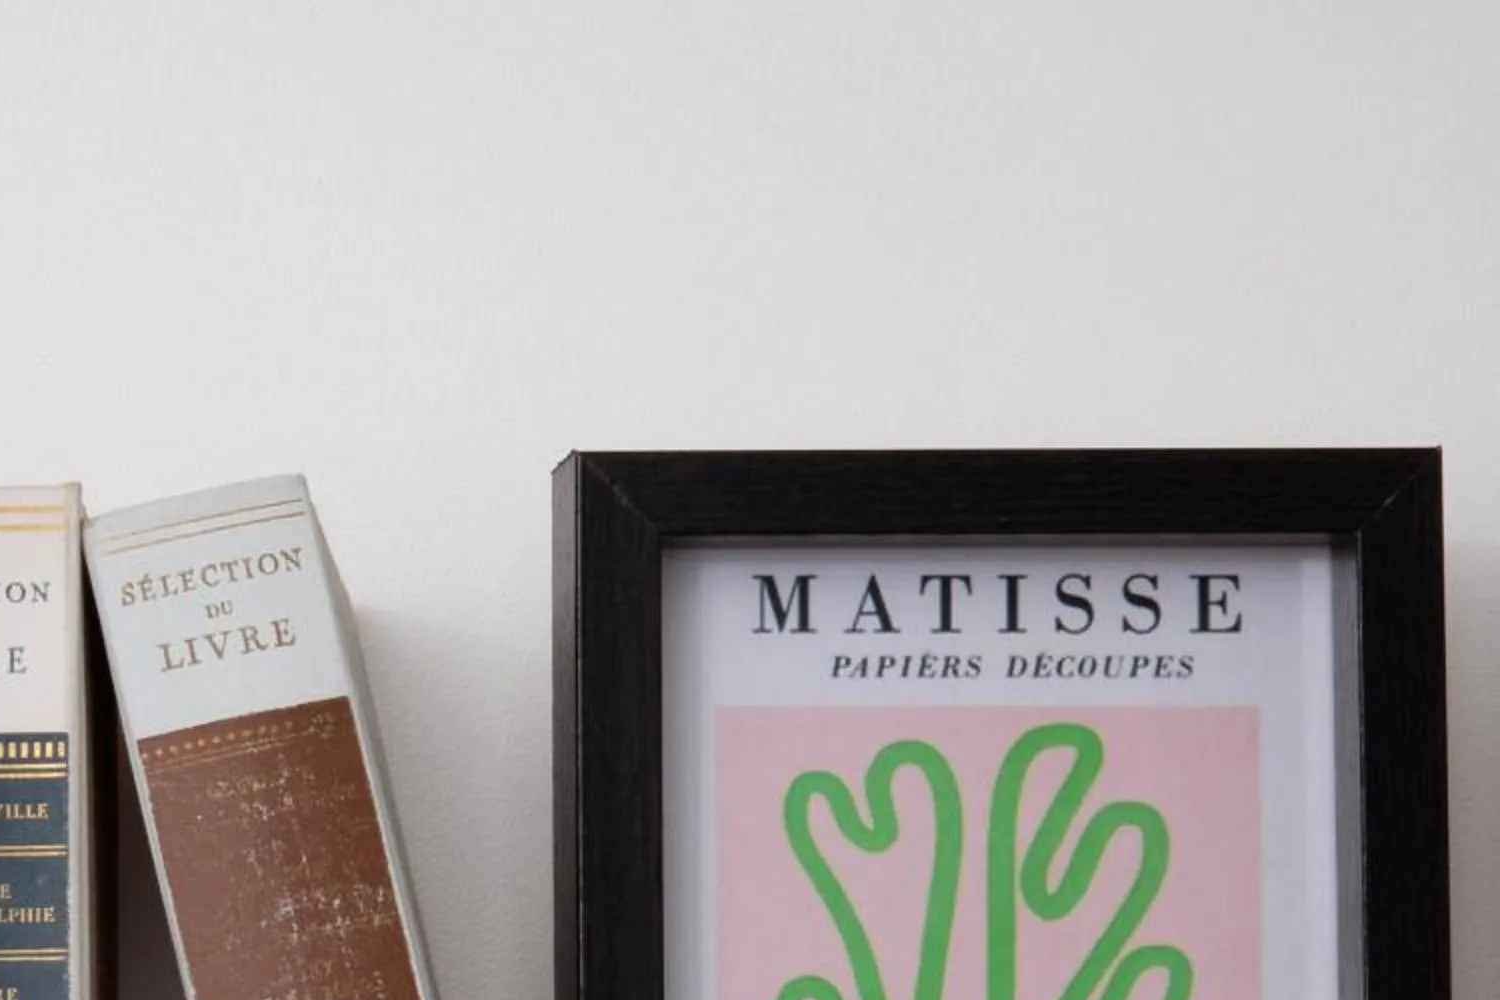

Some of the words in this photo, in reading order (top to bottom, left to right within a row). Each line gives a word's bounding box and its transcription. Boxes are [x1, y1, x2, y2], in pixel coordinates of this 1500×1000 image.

[121, 547, 302, 607] SÉLECTION
[751, 573, 1243, 635] MATISSE
[205, 600, 234, 619] DU
[158, 618, 297, 673] LIVRE
[1005, 651, 1195, 680] DÉCOUPES
